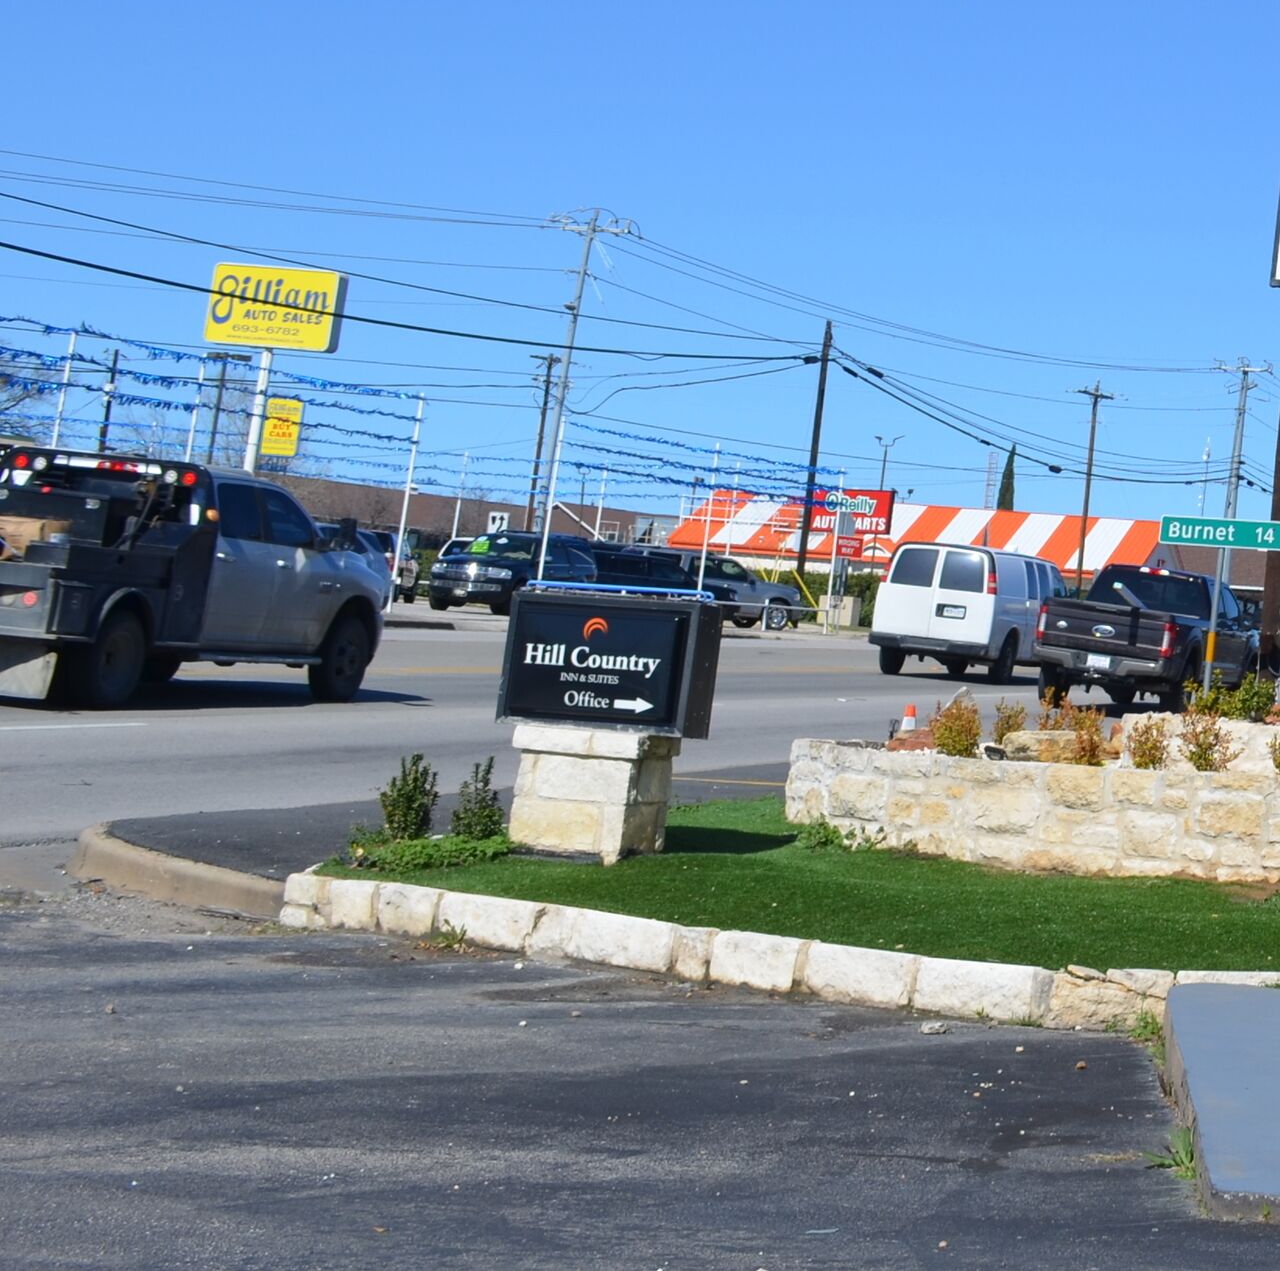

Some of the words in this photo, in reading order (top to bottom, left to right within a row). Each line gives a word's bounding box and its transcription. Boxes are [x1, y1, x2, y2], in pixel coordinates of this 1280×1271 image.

[243, 309, 278, 322] AUTO
[282, 311, 323, 325] SALES
[232, 323, 300, 336] 693-6782
[272, 423, 291, 431] BUY
[826, 491, 877, 515] OReilly
[813, 515, 836, 528] AUT
[853, 516, 886, 531] ARTS
[1168, 521, 1235, 542] Burnet
[1255, 527, 1275, 544] 14
[523, 642, 566, 666] Hill
[570, 645, 662, 679] Country
[560, 672, 579, 682] INN
[579, 673, 587, 682] &
[587, 674, 620, 685] SUITES
[563, 690, 610, 708] Office
